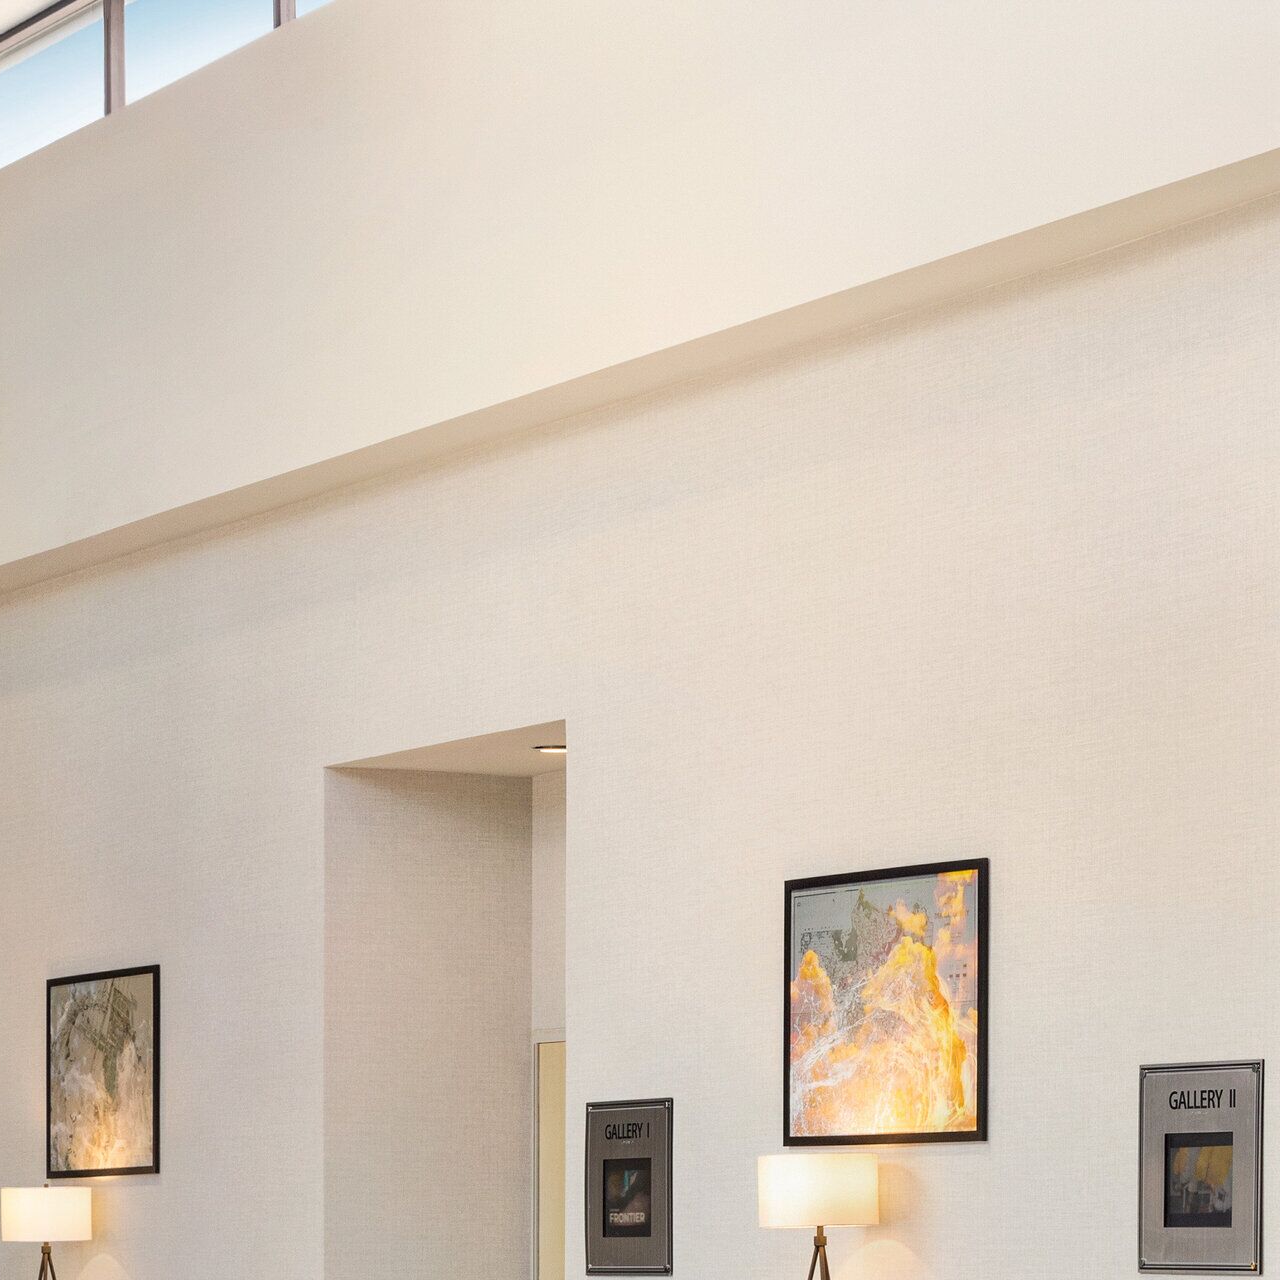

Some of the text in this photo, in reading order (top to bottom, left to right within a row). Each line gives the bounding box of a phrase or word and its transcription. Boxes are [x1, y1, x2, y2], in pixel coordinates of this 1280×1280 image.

[1169, 1088, 1236, 1110] GALLERY II
[605, 1122, 650, 1140] GALLERY I
[609, 1212, 646, 1223] FRONTIER
